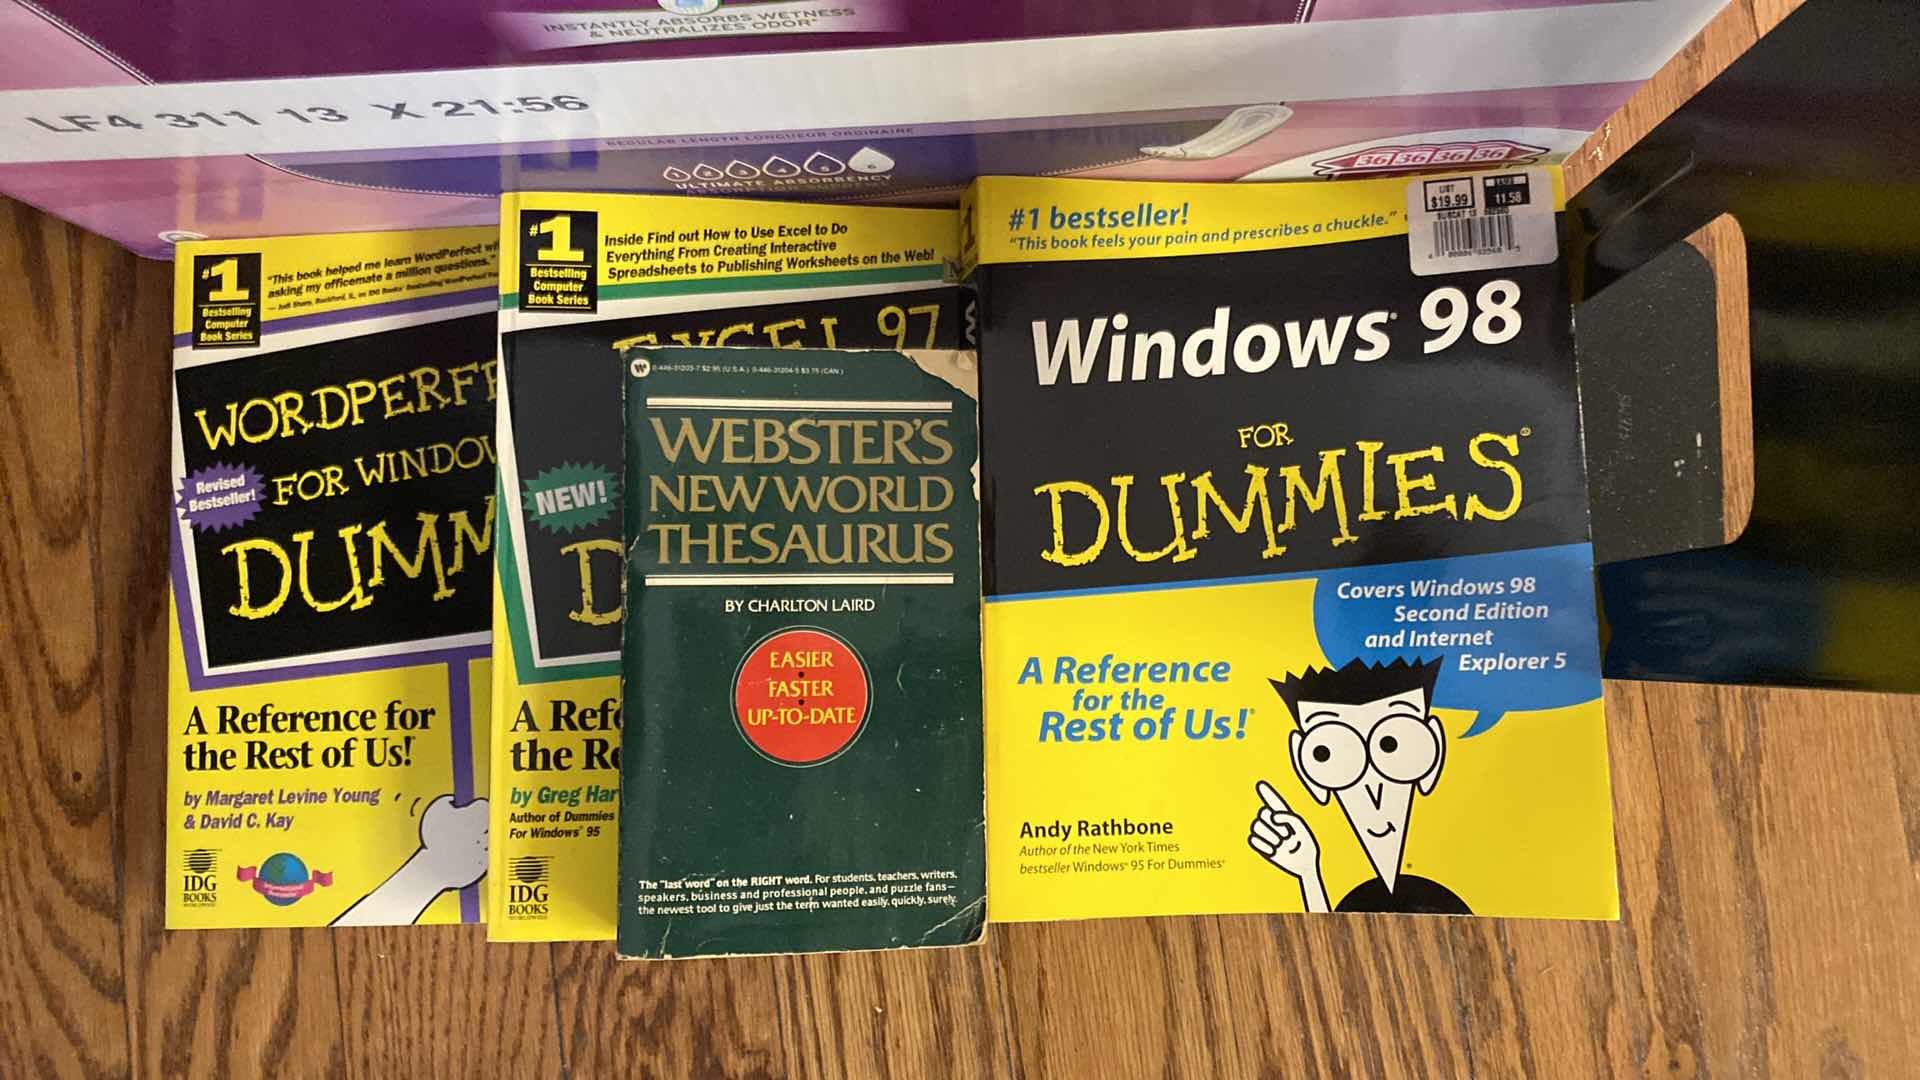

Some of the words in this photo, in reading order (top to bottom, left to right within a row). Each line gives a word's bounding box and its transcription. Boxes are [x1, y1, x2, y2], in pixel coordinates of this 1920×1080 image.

[544, 19, 649, 32] INSTANTLY
[657, 14, 752, 26] ABSORBS
[757, 8, 856, 20] WETNESS
[590, 30, 603, 38] &
[610, 22, 745, 37] NEUTRALIZES
[154, 110, 262, 128] 311
[276, 106, 349, 123] 13
[431, 95, 589, 117] 21:56
[606, 138, 676, 147] REGULAR
[680, 135, 739, 144] LENGTH
[744, 131, 827, 142] LONGUEUR
[831, 127, 914, 137] ORDINAIRE
[676, 179, 764, 190] ULTIMATE
[774, 174, 892, 186] ABSORBENCY
[1431, 193, 1468, 209] $19.99
[1009, 207, 1039, 231] #1
[1051, 202, 1189, 231] bestseller!
[529, 216, 584, 261] #1
[605, 233, 643, 246] Inside
[647, 230, 675, 245] Find
[678, 229, 699, 242] out
[703, 228, 731, 241] How
[734, 227, 747, 239] to
[751, 226, 774, 238] Use
[778, 224, 812, 237] Excel
[815, 223, 828, 235] to
[831, 223, 848, 234] Do
[1052, 235, 1088, 249] book
[1092, 234, 1125, 248] feels
[1129, 235, 1162, 249] your
[1165, 231, 1198, 248] pain
[1202, 229, 1229, 243] and
[1233, 223, 1309, 244] prescribes
[325, 261, 362, 277] helped
[414, 243, 482, 263] WordPerfect
[606, 248, 675, 264] Everything
[678, 246, 710, 259] From
[713, 243, 767, 257] Creating
[770, 239, 837, 254] Interactive
[530, 267, 587, 280] Bestselling
[608, 263, 697, 281] Spreadsheets
[701, 262, 714, 273] to
[717, 258, 783, 273] Publishing
[786, 254, 860, 269] Worksheets
[862, 255, 878, 265] on
[881, 252, 901, 264] the
[904, 249, 934, 261] Web!
[202, 258, 249, 301] #1
[268, 284, 303, 299] asking
[324, 273, 383, 291] officemate
[533, 280, 584, 293] Computer
[528, 294, 554, 304] Book
[556, 294, 589, 305] Series
[205, 319, 249, 330] Computer
[877, 304, 940, 350] 97
[1031, 306, 1393, 386] Windows
[1419, 280, 1523, 354] 98
[649, 416, 953, 465] WEBSTER'S
[1237, 422, 1293, 449] FOR
[196, 475, 245, 495] Revised
[272, 466, 349, 506] FOR
[650, 475, 767, 512] NEW
[772, 475, 955, 513] WORLD
[188, 489, 257, 513] Bestseller!
[535, 480, 608, 516] NEW!
[1034, 431, 1524, 568] DUMMIES
[648, 522, 954, 566] THESAURUS
[1337, 581, 1404, 599] Covers
[1410, 578, 1505, 598] Windows
[1509, 576, 1536, 595] 98
[725, 600, 744, 612] BY
[748, 599, 827, 612] CHARLTON
[832, 598, 875, 612] LAIRD
[1394, 603, 1469, 623] Second
[1474, 601, 1549, 621] Edition
[1365, 630, 1404, 649] and
[1409, 629, 1494, 648] Internet
[770, 651, 834, 669] EASIER
[1017, 656, 1042, 685] A
[1053, 654, 1231, 685] Reference
[1459, 653, 1549, 675] Explorer
[1554, 652, 1567, 669] 5
[768, 680, 834, 698] FASTER
[1072, 688, 1113, 712] for
[1121, 688, 1164, 711] the
[183, 705, 208, 735] A
[216, 703, 377, 735] Reference
[385, 700, 435, 731] for
[510, 700, 540, 733] A
[747, 707, 857, 726] UP-TO-DATE
[1039, 711, 1124, 743] Rest
[1133, 707, 1177, 742] of
[1184, 708, 1248, 741] Us!
[183, 740, 237, 771] the
[244, 739, 312, 770] Rest
[322, 736, 358, 769] of
[366, 735, 413, 767] Us!
[510, 738, 573, 772] the
[184, 791, 202, 809] by
[205, 790, 274, 808] Margaret
[278, 789, 328, 804] Levine
[333, 787, 381, 806] Young
[511, 787, 532, 808] by
[537, 786, 583, 807] Greg
[184, 814, 196, 830] &
[200, 813, 242, 829] David
[246, 813, 261, 829] C.
[265, 812, 294, 831] Kay
[509, 812, 545, 823] Author
[549, 811, 561, 822] of
[564, 810, 615, 822] Dummies
[509, 828, 527, 839] For
[530, 827, 579, 839] Windows
[586, 826, 600, 837] 95
[1020, 820, 1072, 842] Andy
[1077, 818, 1173, 837] Rathbone
[1019, 845, 1057, 857] Author
[1073, 844, 1091, 855] the
[1093, 843, 1119, 854] New
[1120, 842, 1145, 854] York
[1146, 841, 1180, 853] Times
[1019, 861, 1071, 875] bestseller
[1131, 860, 1145, 871] 95
[1147, 859, 1164, 871] For
[1167, 858, 1223, 870] Dummies
[184, 875, 216, 891] IDG
[509, 884, 548, 903] IDG
[639, 880, 657, 890] The
[731, 877, 748, 888] the
[751, 876, 783, 887] RIGHT
[815, 874, 829, 884] For
[691, 890, 737, 902] business
[740, 888, 760, 899] and
[763, 886, 827, 901] professional
[869, 883, 889, 895] and
[891, 882, 923, 896] puzzle
[184, 892, 216, 902] BOOKS
[657, 904, 694, 915] newest
[696, 903, 716, 914] tool
[732, 902, 752, 914] give
[822, 898, 859, 909] wanted
[509, 904, 548, 915] BOOKS
